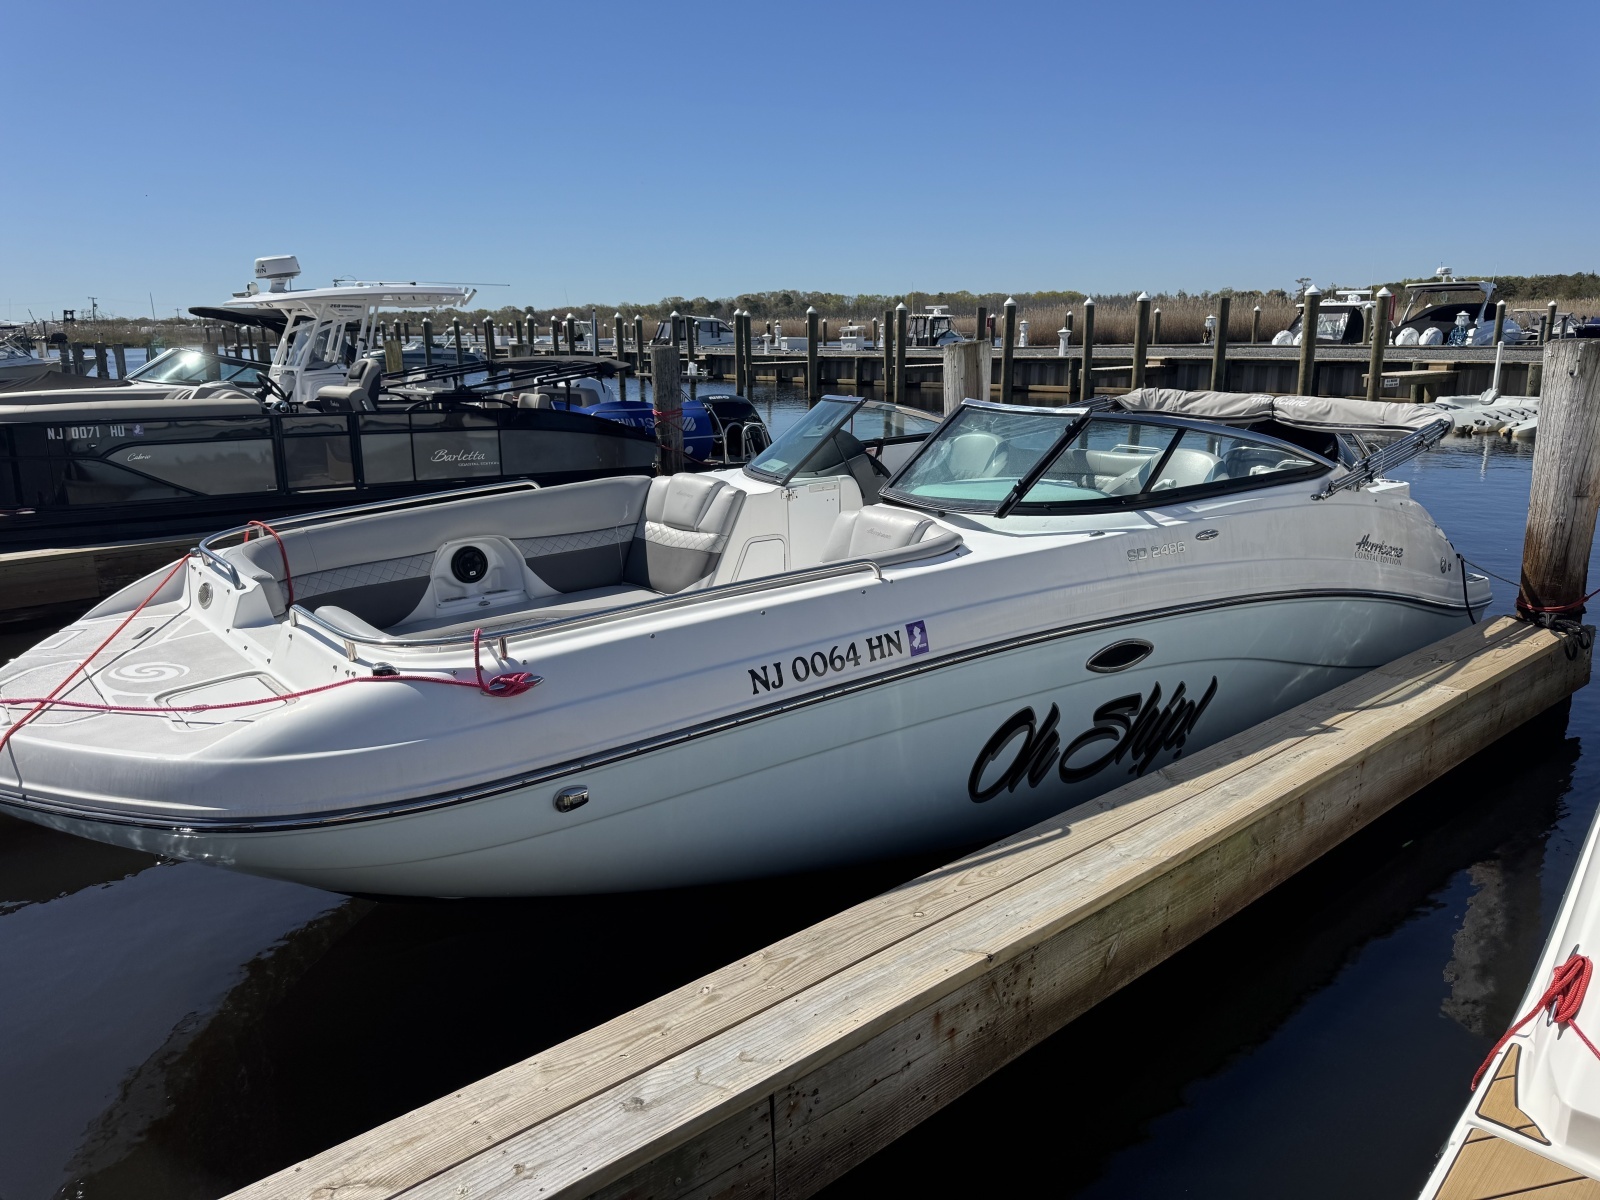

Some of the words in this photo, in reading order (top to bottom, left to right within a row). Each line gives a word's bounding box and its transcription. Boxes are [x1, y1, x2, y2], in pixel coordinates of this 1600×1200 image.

[47, 427, 64, 440] NJ
[71, 426, 100, 439] 0071
[110, 425, 125, 437] HU
[431, 449, 485, 461] Barletta
[1126, 547, 1148, 561] SD
[1151, 541, 1186, 558] 2486
[1356, 533, 1404, 558] Hurricane
[1354, 551, 1379, 562] COASTAL
[1379, 555, 1402, 566] EDITION
[748, 662, 784, 695] NJ
[791, 641, 861, 682] 0064
[866, 630, 903, 662] HN
[968, 701, 1061, 804] Oh
[1058, 675, 1219, 785] Ship!
